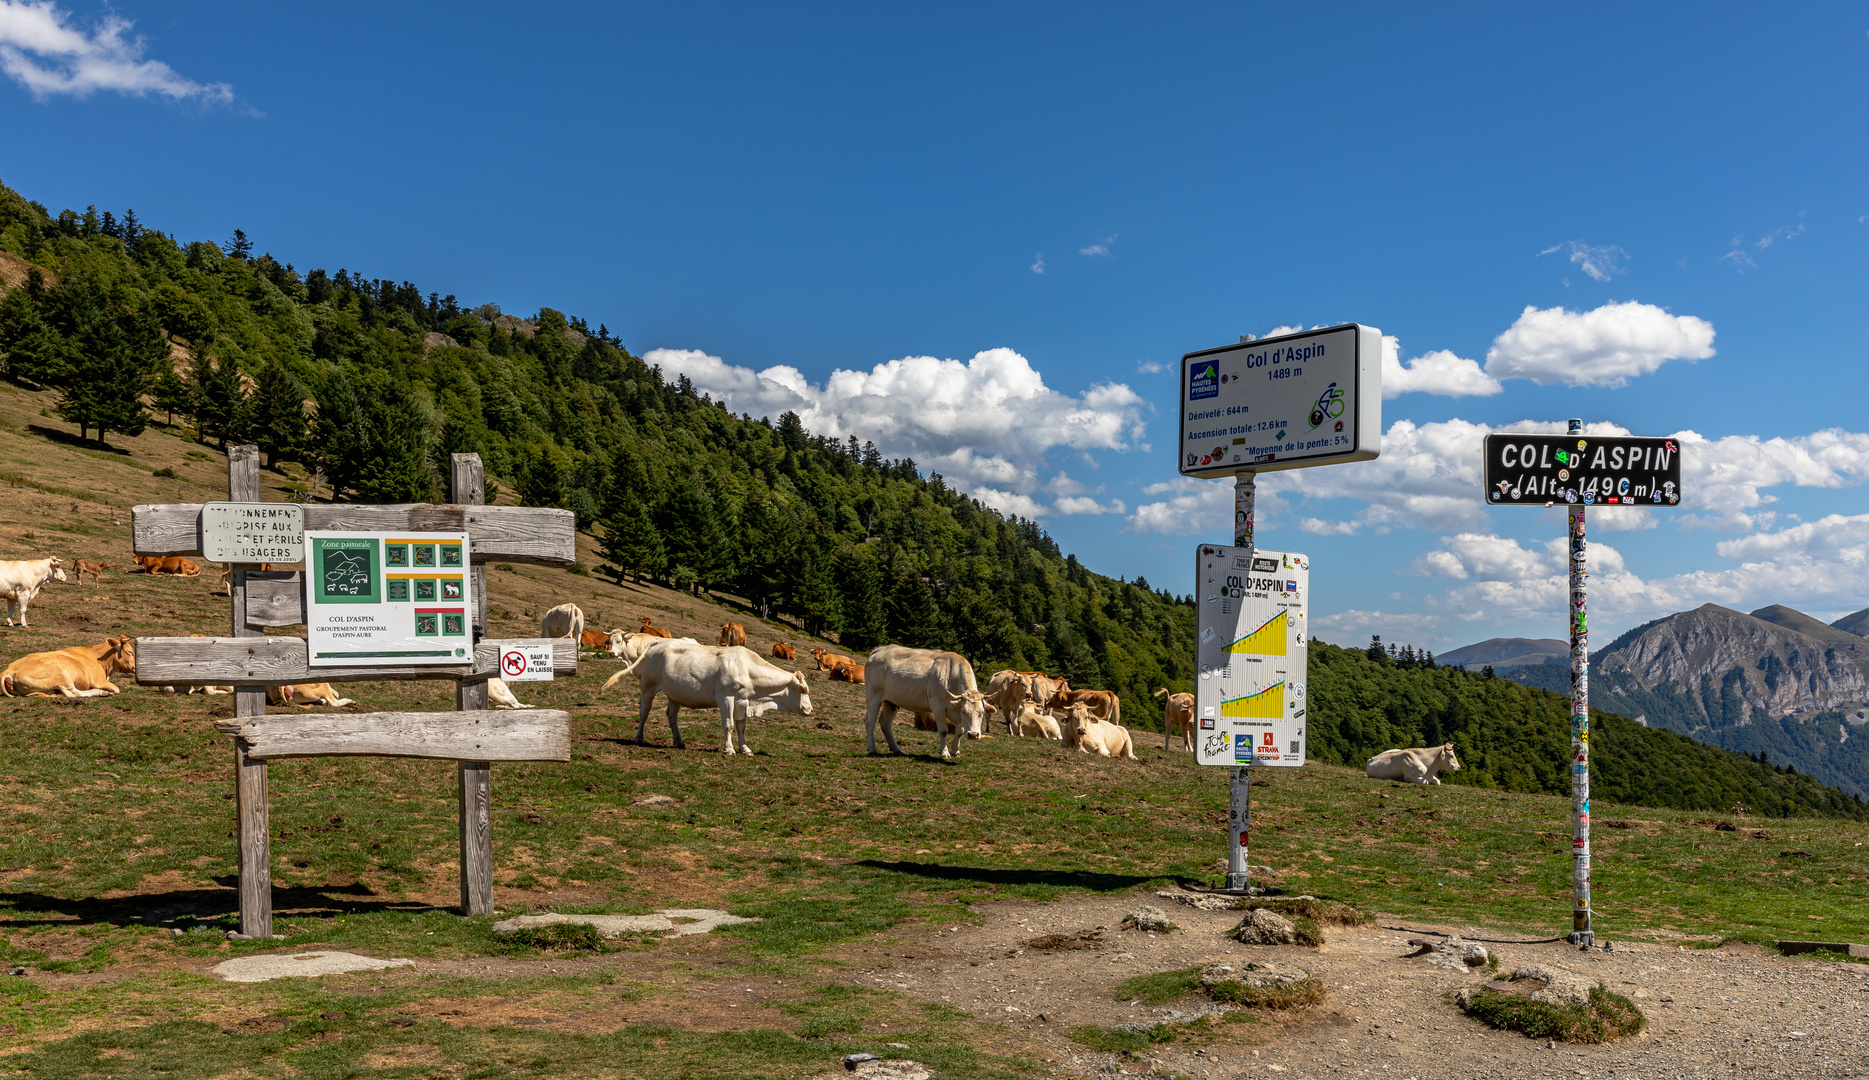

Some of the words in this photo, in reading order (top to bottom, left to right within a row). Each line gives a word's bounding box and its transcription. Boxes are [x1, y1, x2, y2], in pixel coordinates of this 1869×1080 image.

[1246, 351, 1267, 369] Col
[1272, 343, 1325, 364] d'Aspin
[1267, 368, 1290, 380] 1489
[1294, 367, 1302, 376] m
[1191, 379, 1212, 388] HAUTES
[1188, 428, 1228, 440] Ascension
[1248, 444, 1282, 456] Moyenne
[1284, 442, 1294, 452] de
[1297, 440, 1304, 450] la
[1502, 444, 1552, 468] COL
[272, 522, 292, 531] AUX
[252, 534, 264, 544] ET
[268, 533, 303, 544] PÉRILS
[321, 540, 340, 548] Zone
[341, 540, 371, 549] pastorale
[242, 548, 291, 557] USAGERS
[1226, 576, 1243, 588] COL
[1246, 577, 1283, 592] D'ASPIN
